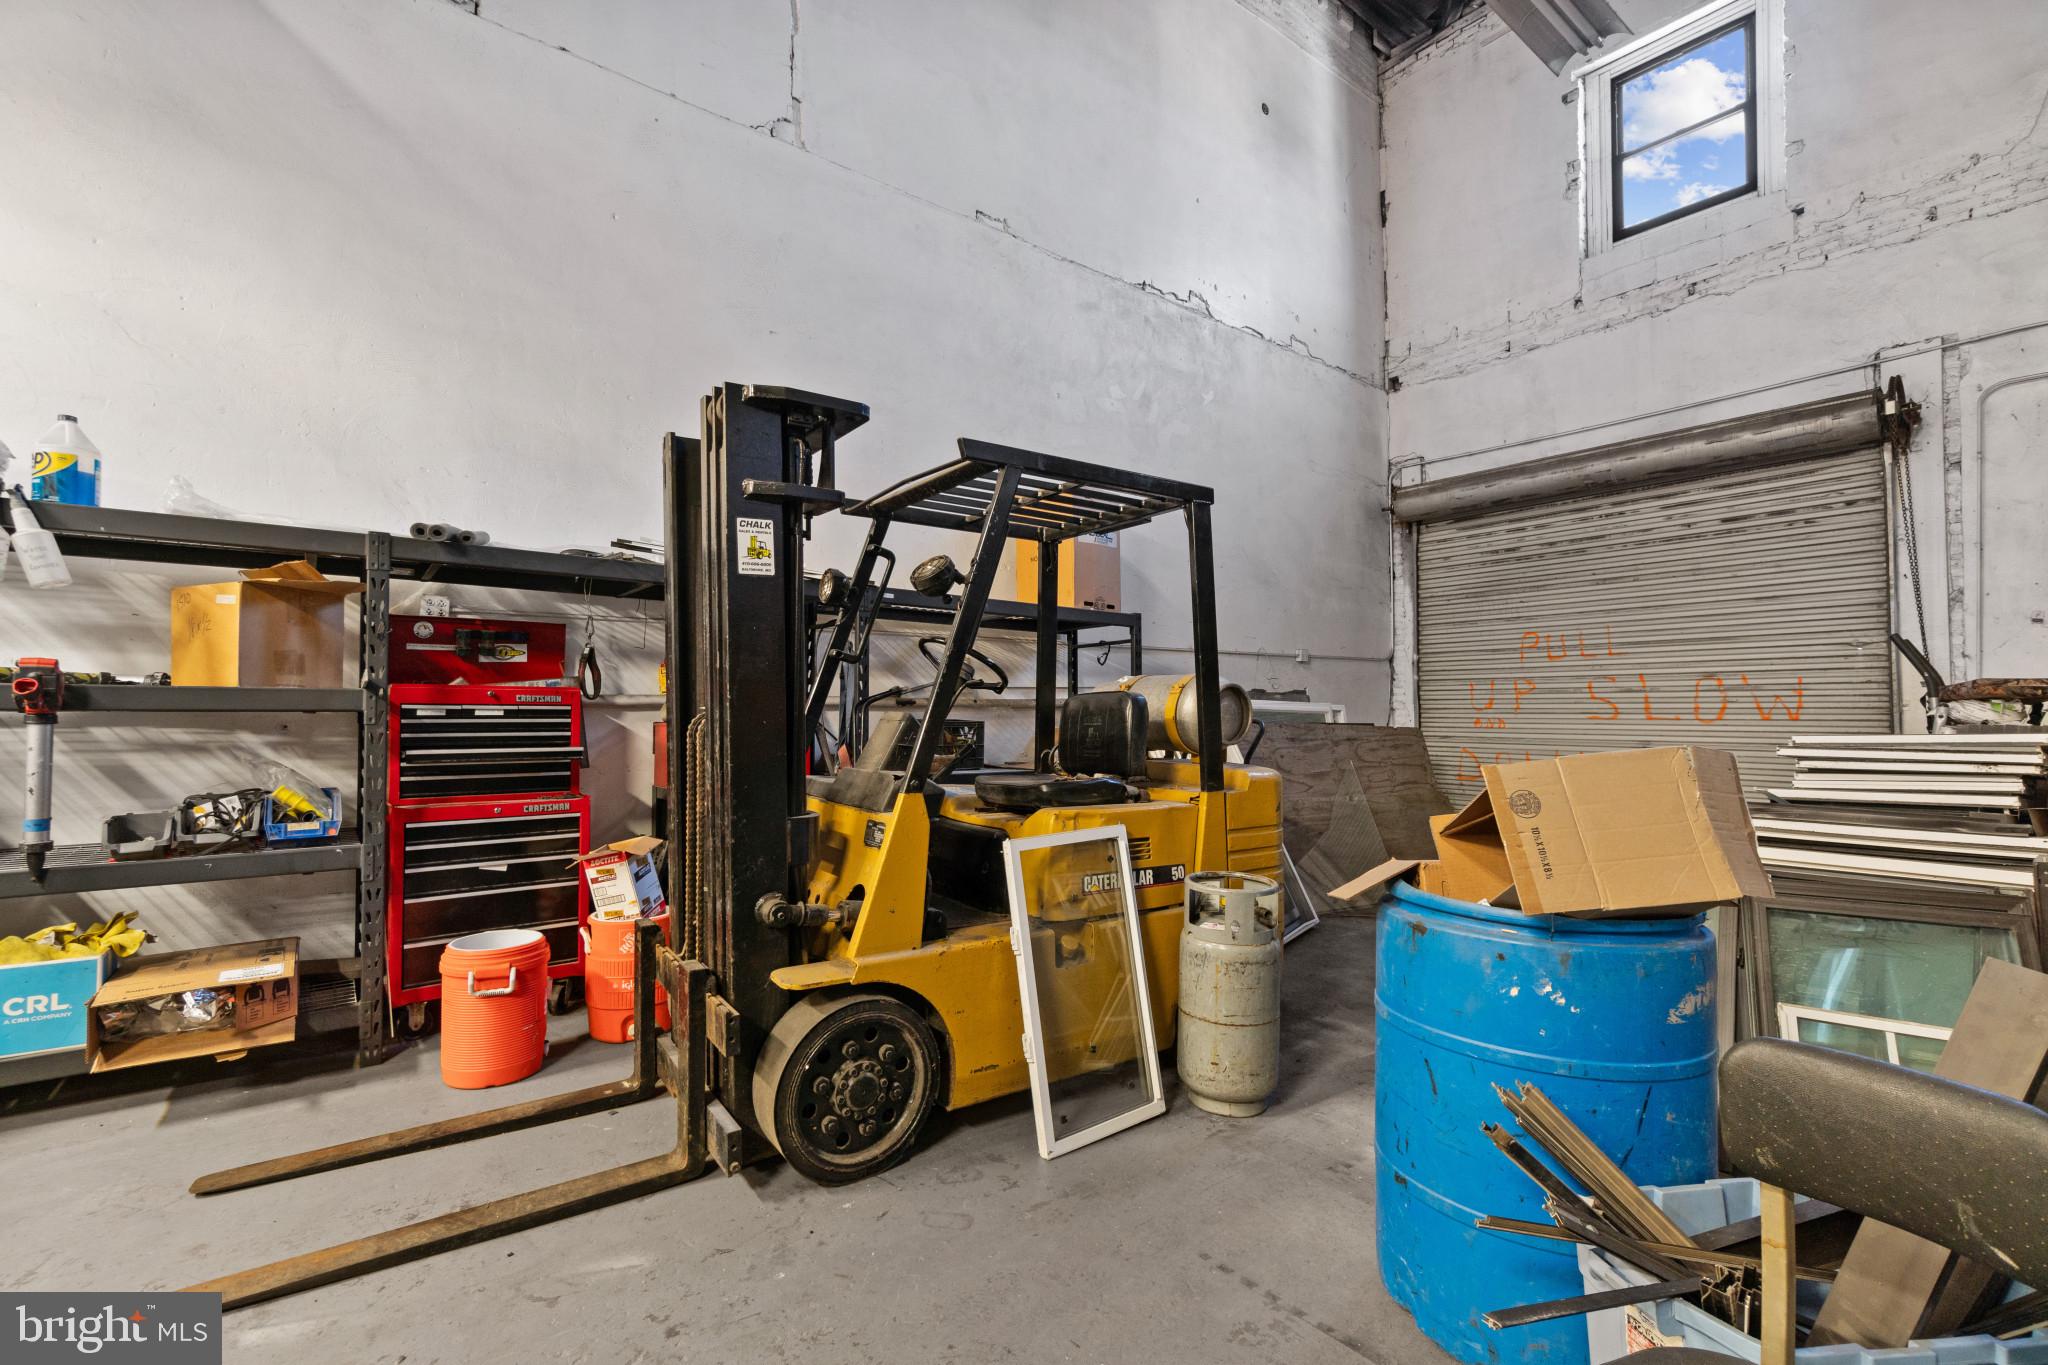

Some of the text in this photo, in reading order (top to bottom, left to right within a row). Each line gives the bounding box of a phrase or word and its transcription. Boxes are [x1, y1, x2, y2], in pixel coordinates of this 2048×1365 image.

[739, 519, 772, 530] CHALK
[1520, 625, 1628, 663] PULL
[515, 694, 562, 703] CRAFTSMAN
[1469, 673, 1804, 724] UP SLOW
[523, 802, 570, 813] CRAFTSMAN
[590, 856, 620, 867] LOCTITE
[1084, 865, 1185, 892] CATERLAR 50
[2, 993, 71, 1016] CRL
[31, 1011, 73, 1022] COMPANY
